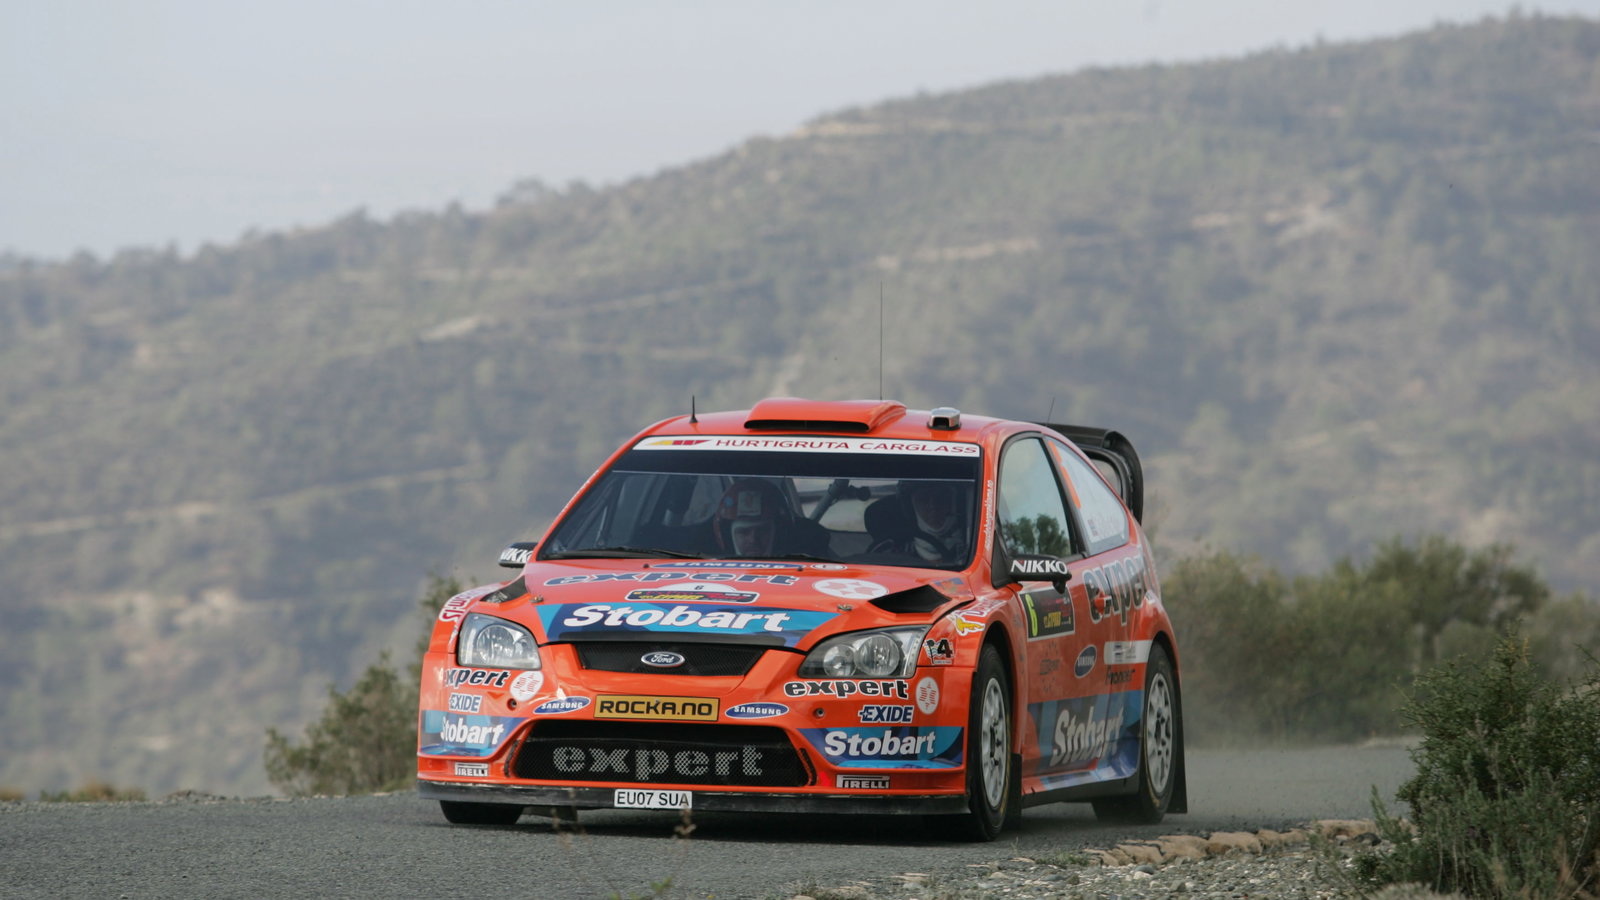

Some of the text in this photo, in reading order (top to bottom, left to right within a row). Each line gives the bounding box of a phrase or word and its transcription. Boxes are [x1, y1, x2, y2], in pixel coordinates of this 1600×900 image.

[715, 438, 978, 455] HURTIGRUTA CARGLASS
[500, 547, 534, 564] NIKK
[674, 561, 787, 569] SAMSUNG
[1010, 560, 1068, 574] NIKKO
[544, 571, 800, 587] expert
[563, 603, 791, 632] Stobart
[1025, 593, 1038, 637] 6
[650, 653, 676, 665] Ford
[445, 668, 511, 688] xpert
[785, 680, 909, 699] expert
[449, 693, 482, 713] EXIDE
[540, 701, 584, 712] SAMSUNG
[599, 699, 713, 717] ROCKA.NO
[733, 705, 782, 716] SAMSUNG
[862, 705, 914, 723] EXIDE
[440, 717, 504, 746] Stobart
[1050, 705, 1124, 767] Stobart
[824, 730, 936, 757] Stobart
[455, 762, 489, 777] PIRELLI
[552, 743, 763, 780] expert
[836, 774, 890, 789] PIRELLI
[616, 791, 690, 807] EU07 SUA
